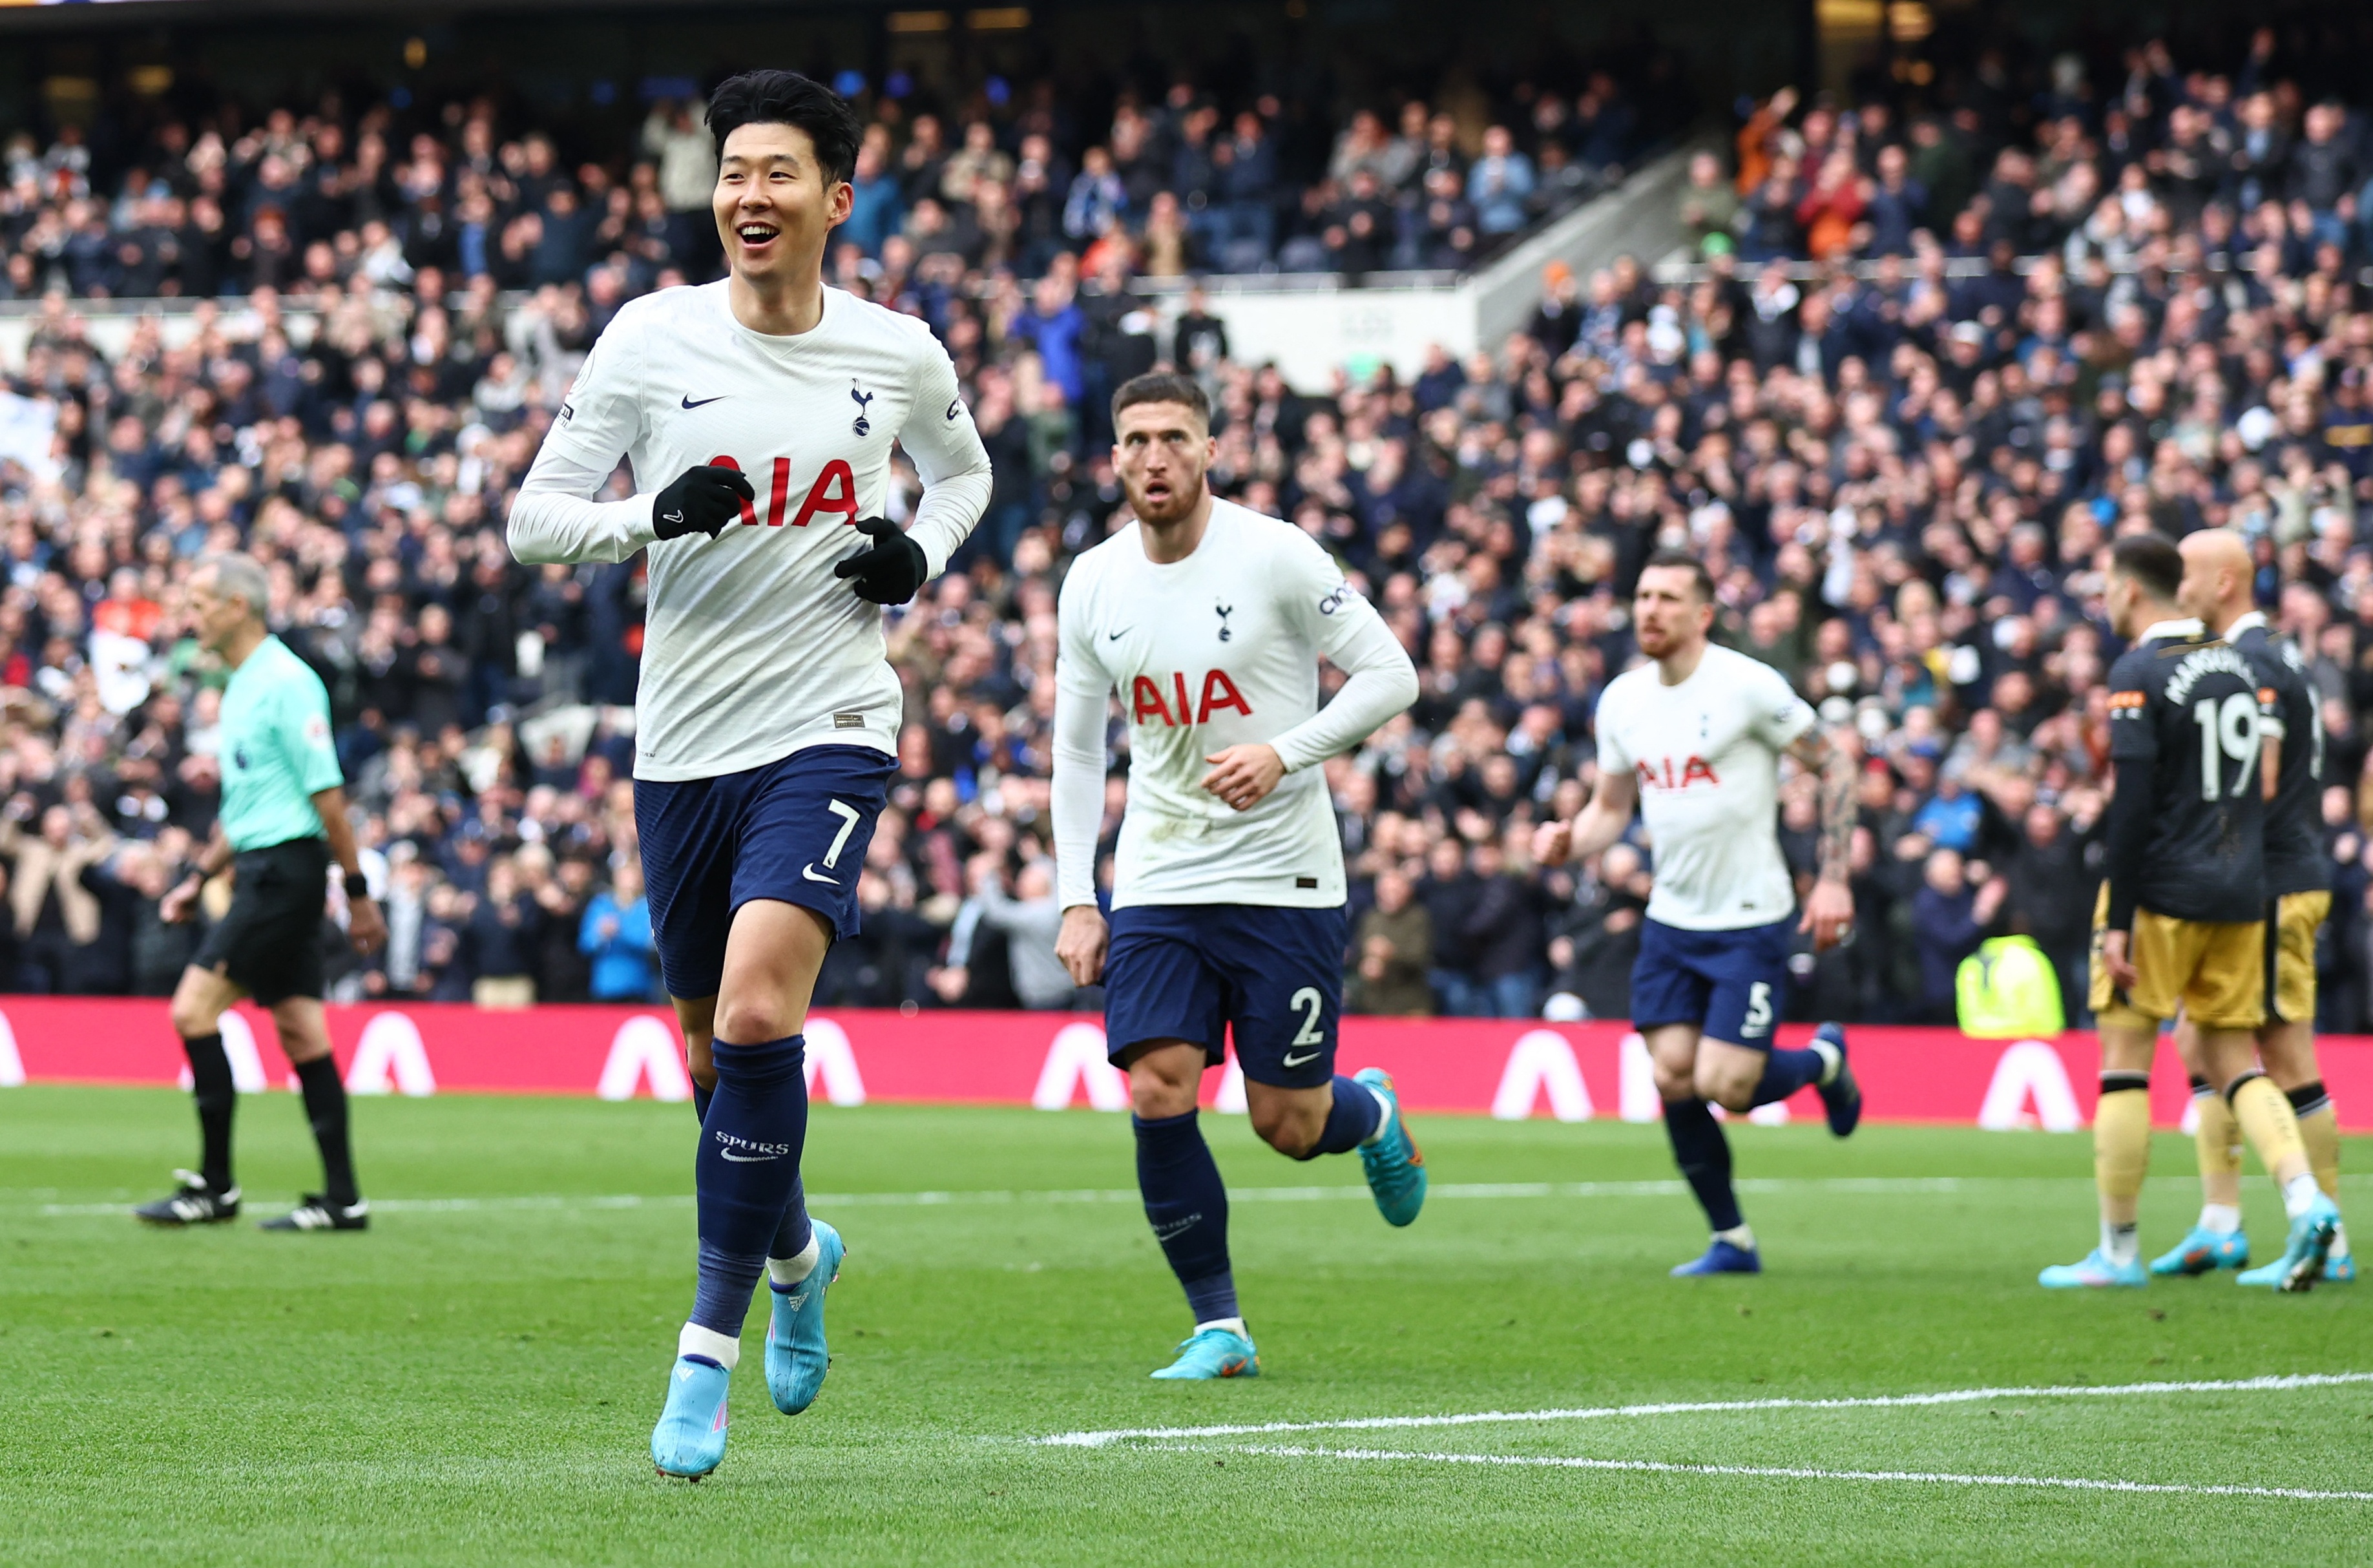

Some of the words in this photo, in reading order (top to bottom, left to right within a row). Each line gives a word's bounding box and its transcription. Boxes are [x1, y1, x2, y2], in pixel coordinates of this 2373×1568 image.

[1134, 668, 1253, 727] AIA
[1635, 755, 1721, 789] AIA
[2193, 692, 2261, 803] 19
[822, 799, 861, 870] 7
[1290, 986, 1324, 1047] 2
[1744, 981, 1773, 1026] 5
[715, 1131, 789, 1155] SPURS
